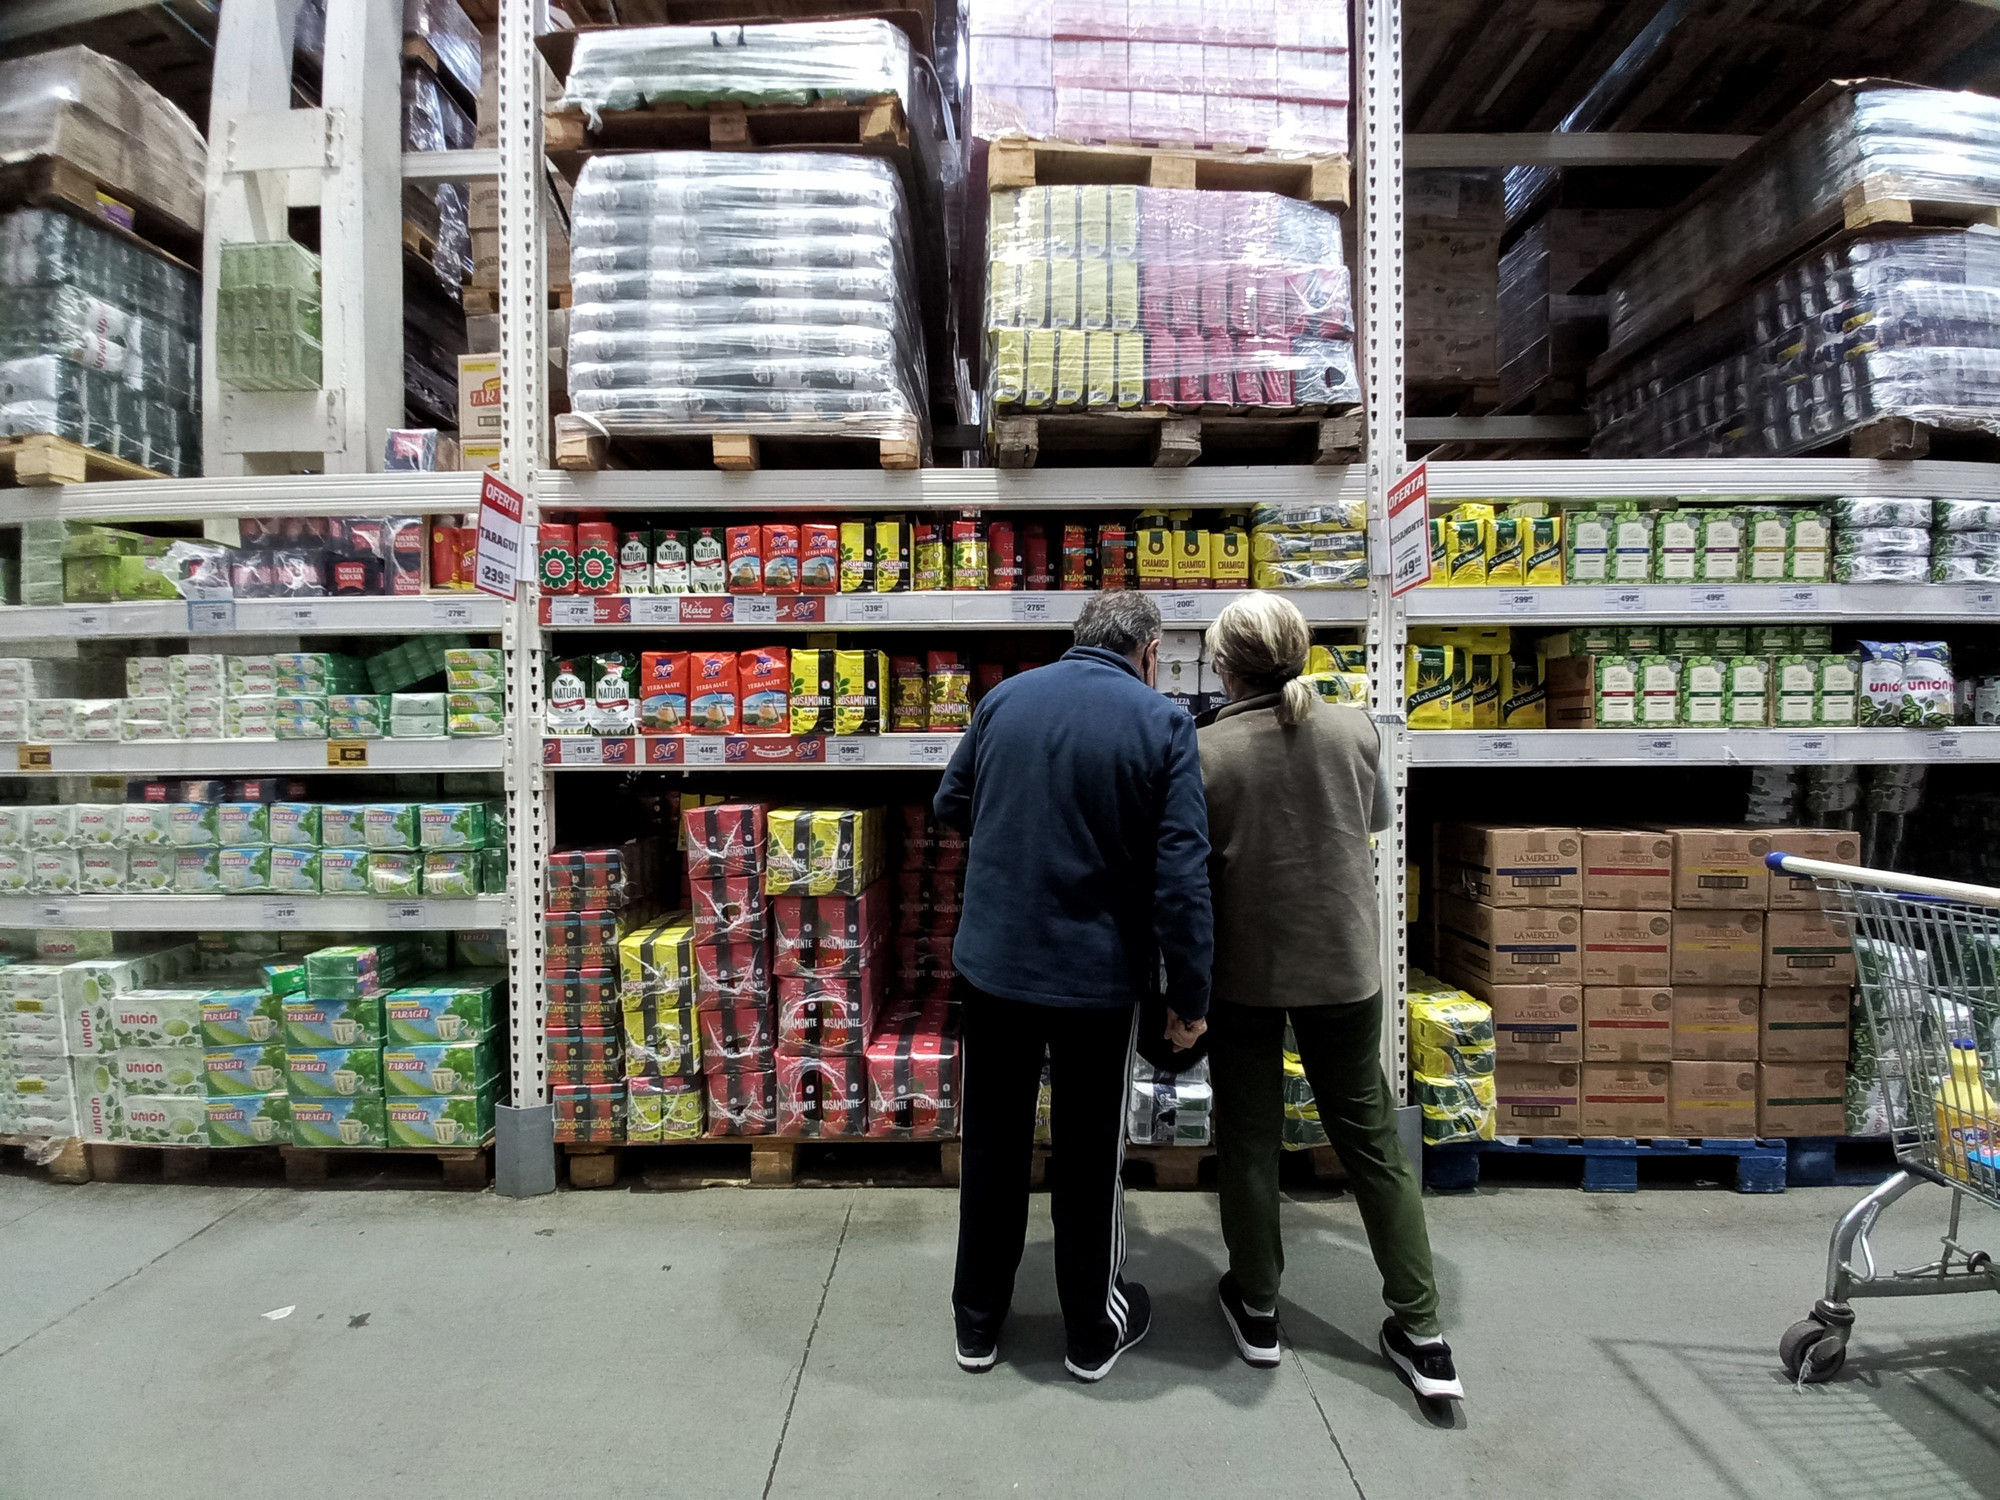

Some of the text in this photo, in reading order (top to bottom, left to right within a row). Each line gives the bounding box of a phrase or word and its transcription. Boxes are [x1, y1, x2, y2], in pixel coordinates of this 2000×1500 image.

[1388, 472, 1424, 510] OFERTA
[486, 484, 519, 515] OFERTA
[481, 526, 518, 553] TARAGUI
[733, 536, 751, 548] SP
[771, 536, 788, 548] SP
[810, 535, 828, 548] SP
[622, 551, 645, 561] NATURA
[659, 551, 684, 561] NATURA
[696, 548, 720, 558] NATURA
[1142, 559, 1169, 568] CHAMIGO
[1178, 560, 1206, 569] CHAMIGO
[1218, 561, 1245, 570] CHAMIGO
[792, 601, 817, 617] SP
[653, 664, 675, 678] SP
[702, 663, 722, 678] SP
[753, 661, 773, 676] SP
[747, 679, 780, 690] YERBA MATE
[554, 687, 582, 699] NATURA
[599, 687, 626, 699] NATURA
[1410, 684, 1452, 705] Mañanita
[1453, 688, 1472, 700] anita
[1506, 688, 1545, 710] Mañanita
[792, 696, 831, 706] ROSAMONTE
[838, 696, 877, 706] ROSAMONTE
[933, 703, 969, 713] ROSAMONTE
[603, 743, 627, 760] SP
[653, 742, 678, 759] SP
[726, 741, 750, 759] SP
[797, 741, 821, 757] SP
[820, 938, 857, 948] ROSAMONTE
[823, 1018, 860, 1028] ROSAMONTE
[823, 1100, 859, 1111] ROSAMONTE
